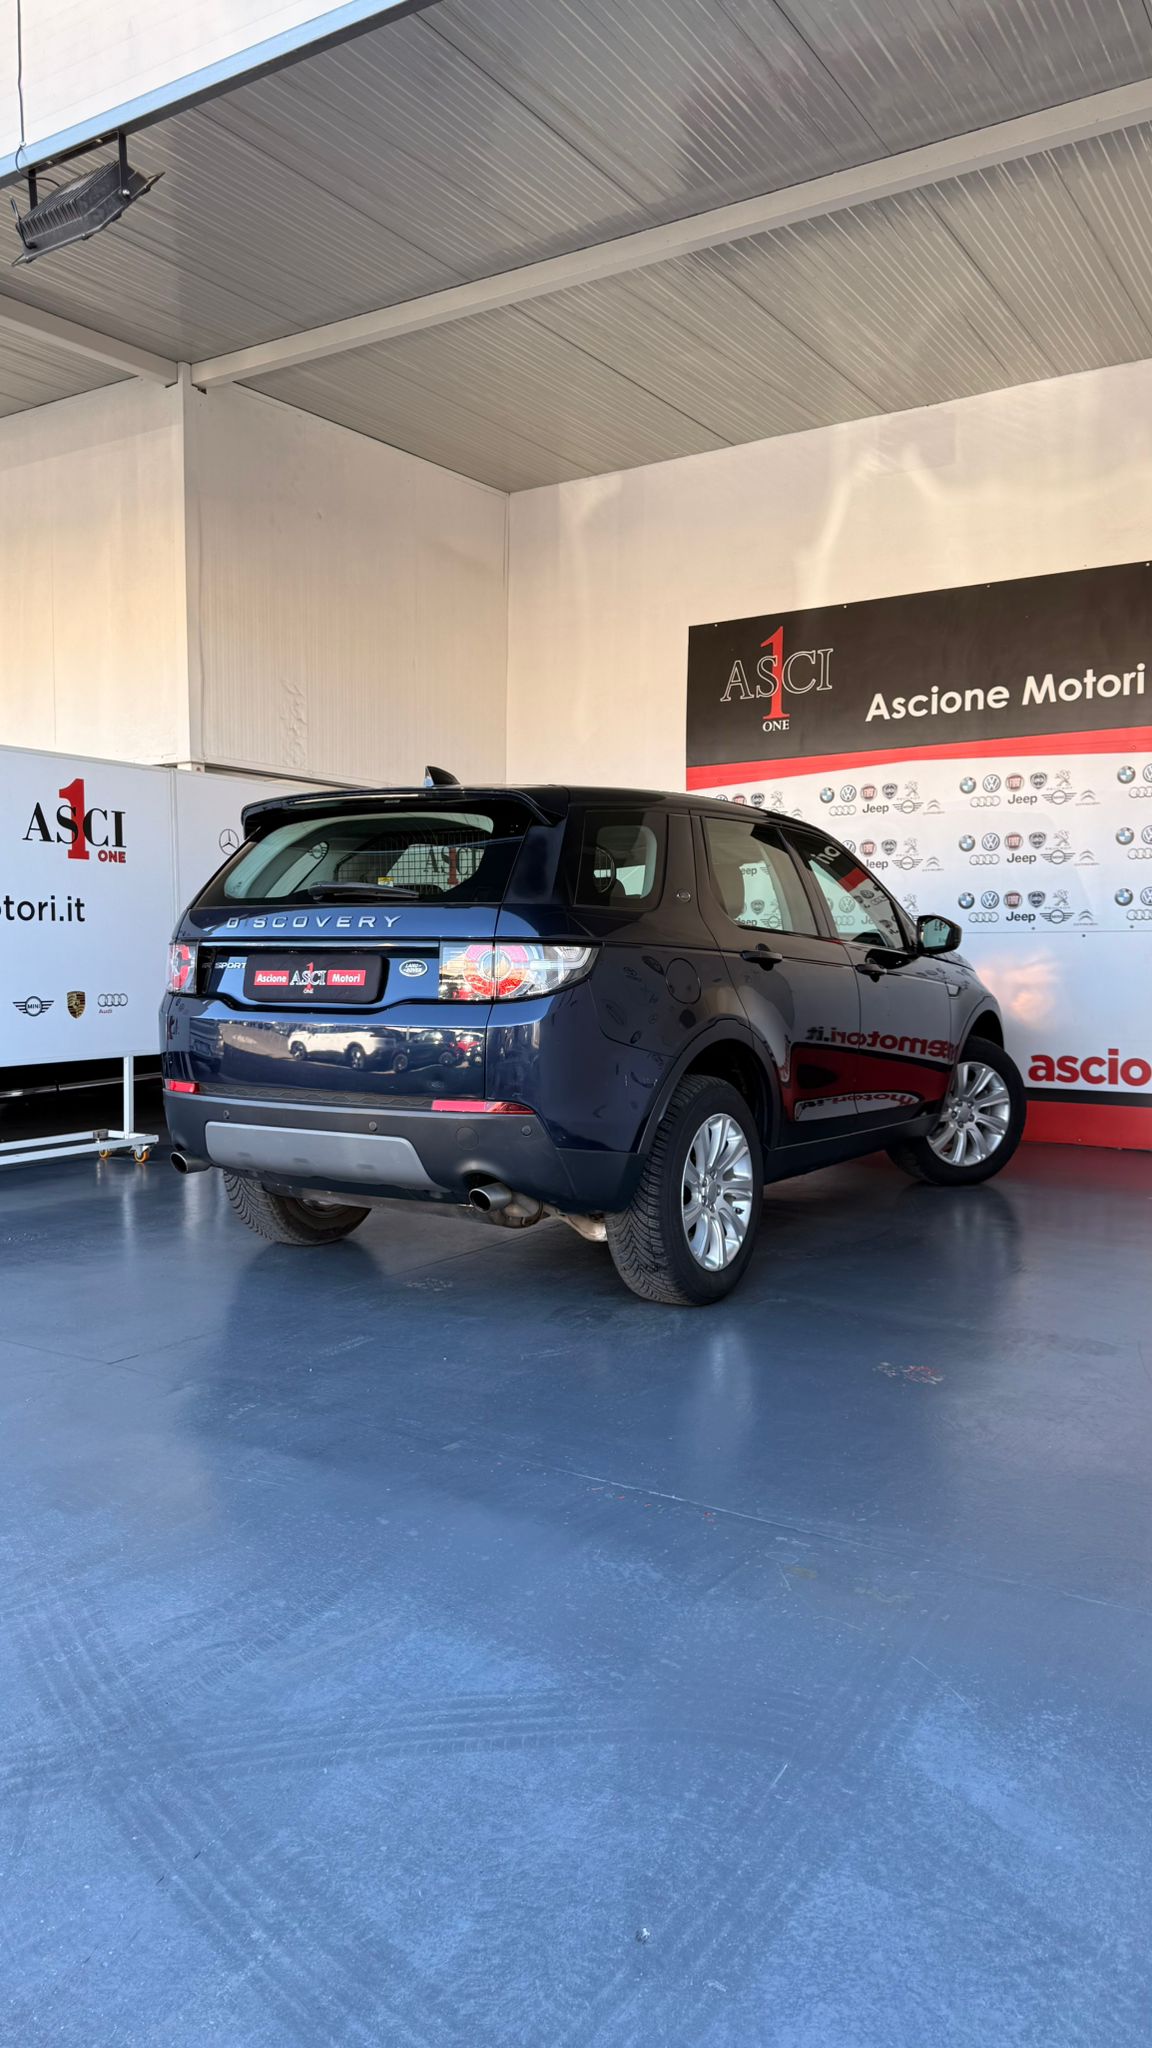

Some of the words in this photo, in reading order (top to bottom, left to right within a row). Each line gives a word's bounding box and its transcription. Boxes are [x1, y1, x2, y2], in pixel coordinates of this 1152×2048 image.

[720, 648, 834, 702] ASCI
[865, 686, 1010, 722] Ascione
[1022, 663, 1146, 706] Motori
[762, 719, 790, 732] ONE
[1007, 794, 1038, 806] Jeep
[862, 803, 890, 815] Jeep
[22, 802, 127, 848] ASCI
[98, 850, 126, 863] ONE
[1006, 853, 1037, 865] Jeep
[741, 867, 757, 876] eep
[0, 895, 86, 922] tori.it
[226, 916, 401, 929] DISCOVERY
[1005, 912, 1036, 923] Jeep
[257, 973, 287, 982] Ascione
[332, 973, 361, 983] Motori
[289, 970, 327, 986] ASCI
[1028, 1048, 1152, 1087] ascio
